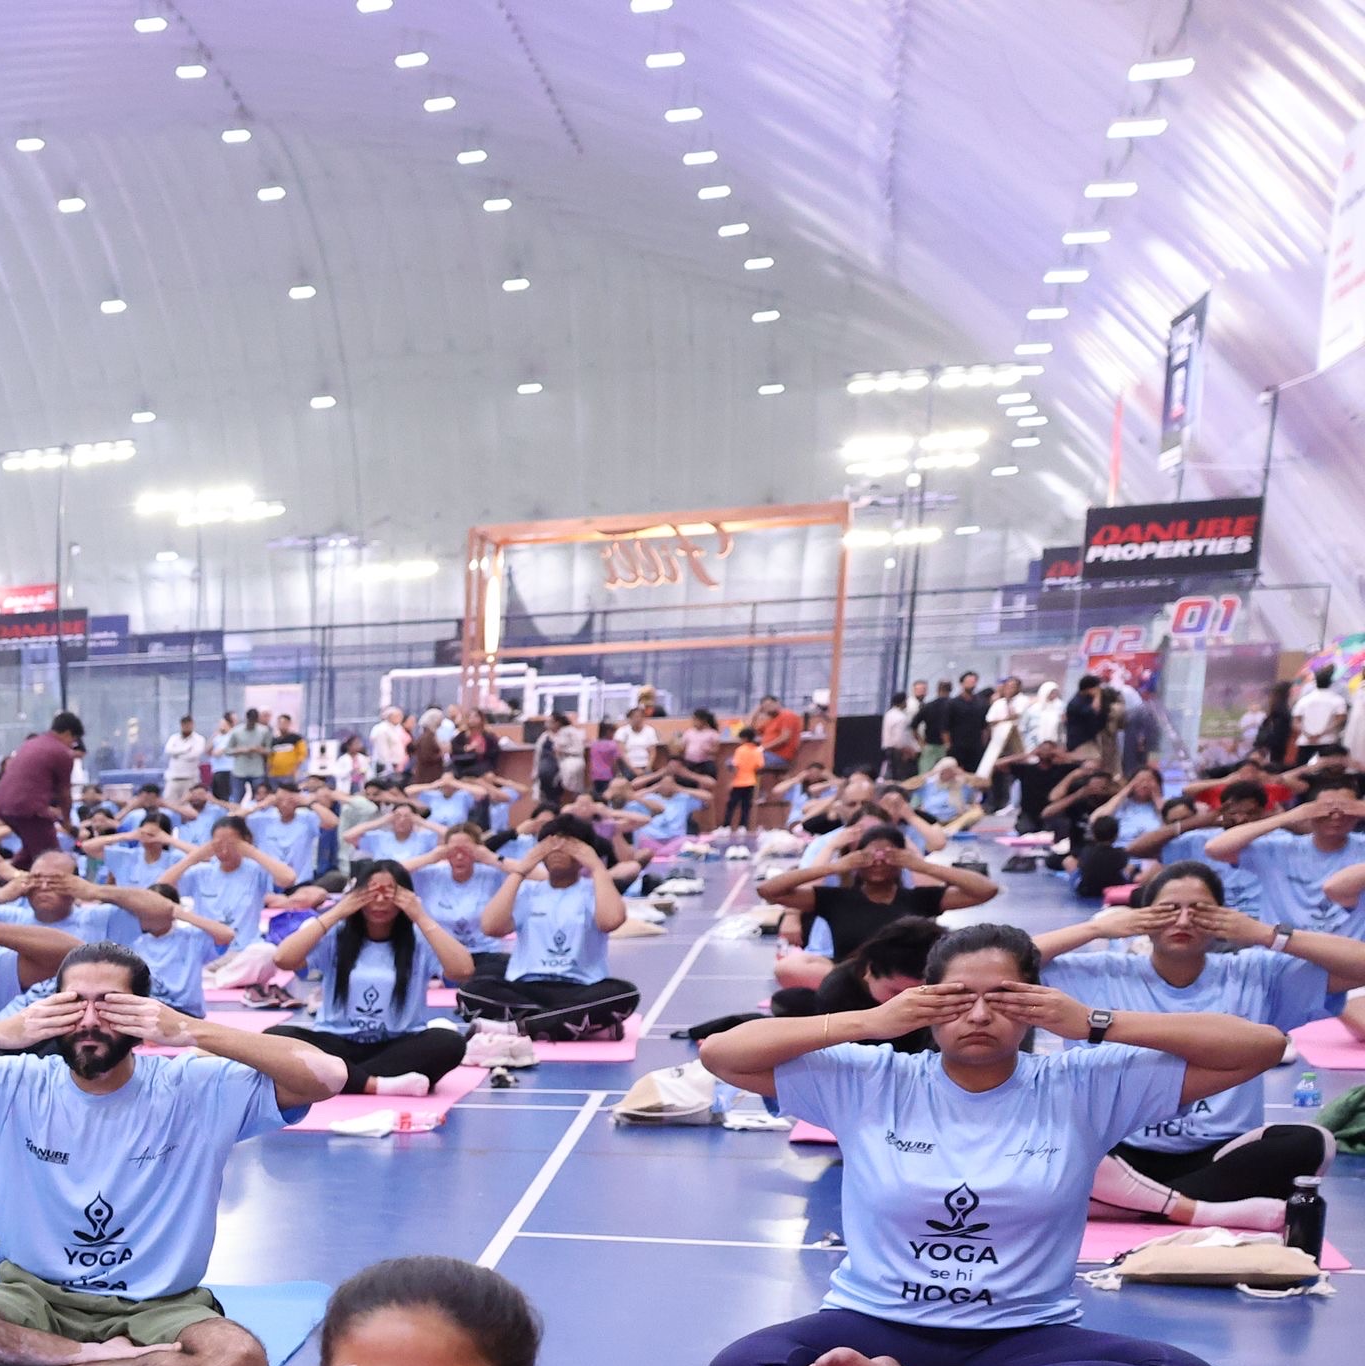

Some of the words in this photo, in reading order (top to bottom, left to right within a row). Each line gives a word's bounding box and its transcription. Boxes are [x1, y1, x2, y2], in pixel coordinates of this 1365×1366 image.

[1093, 516, 1257, 545] DANUBE
[1085, 536, 1253, 563] PROPERTIES
[1171, 596, 1241, 637] 01
[1080, 626, 1146, 657] 02
[63, 1247, 133, 1267] YOGA
[910, 1240, 998, 1264] YOGA
[930, 1270, 951, 1280] se
[956, 1268, 973, 1281] hi
[901, 1282, 993, 1306] HOGA
